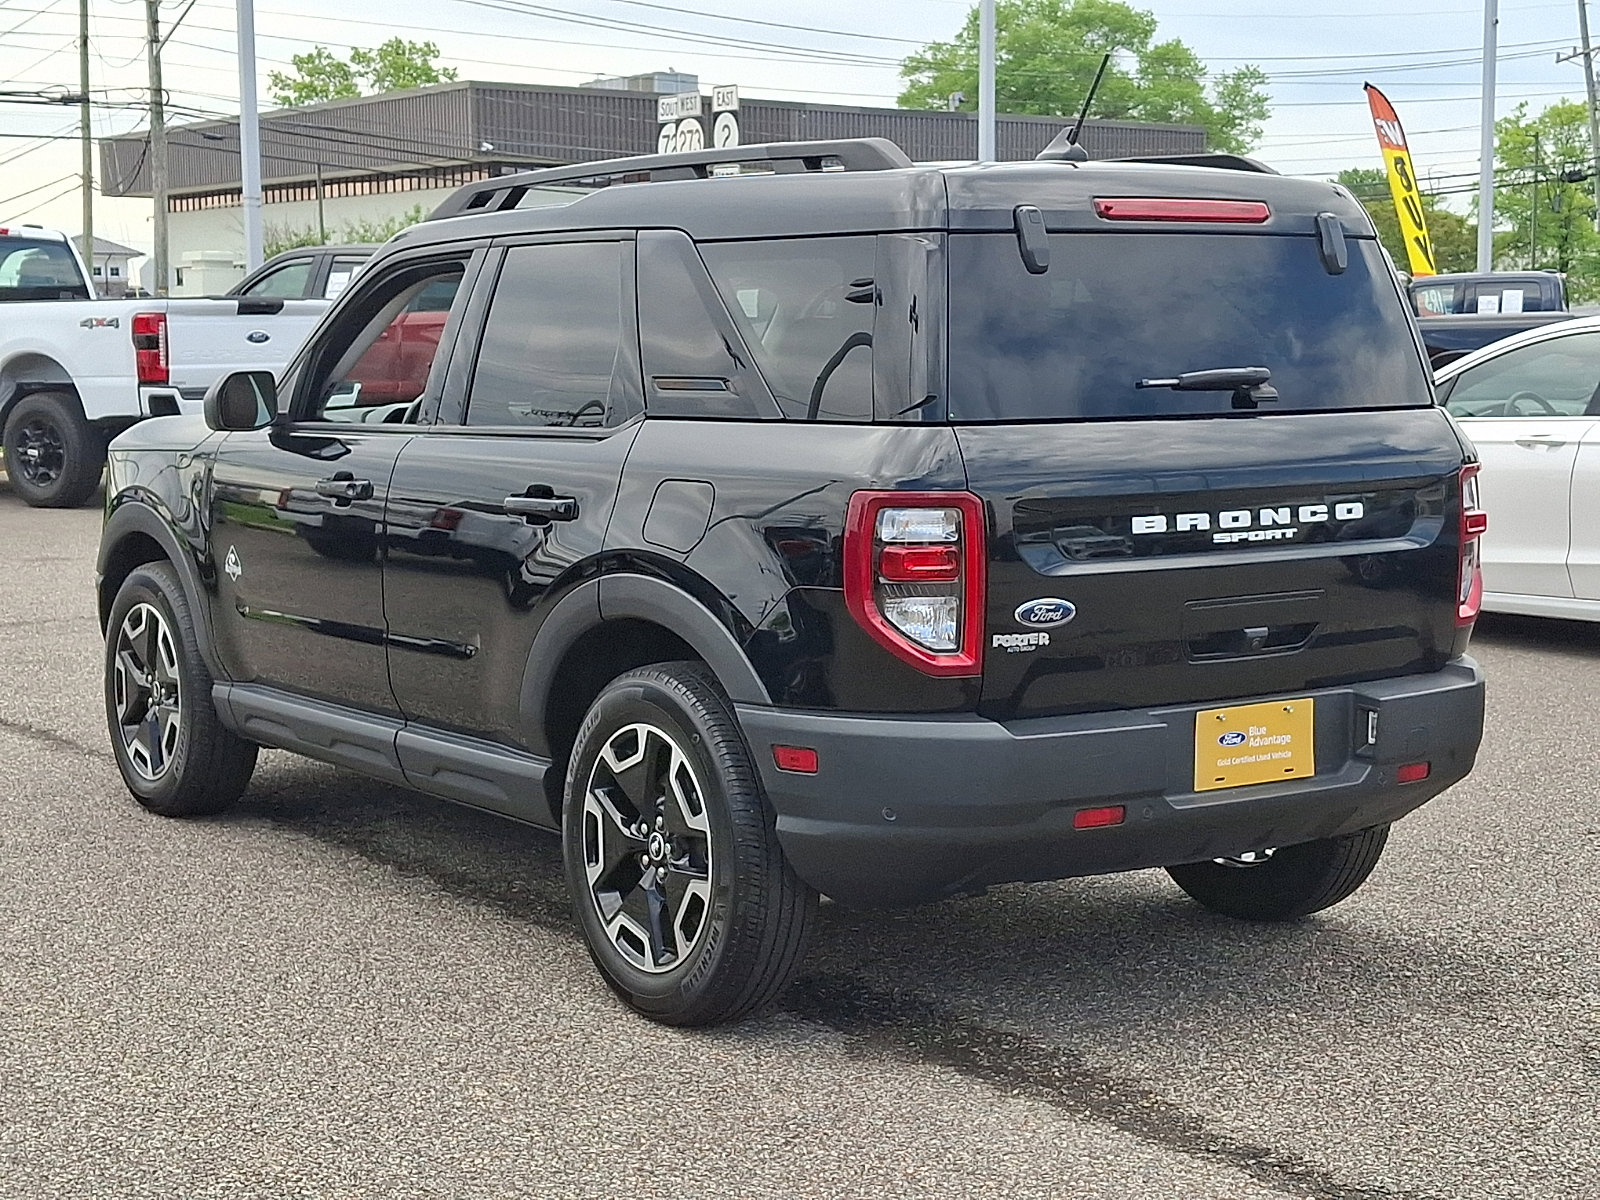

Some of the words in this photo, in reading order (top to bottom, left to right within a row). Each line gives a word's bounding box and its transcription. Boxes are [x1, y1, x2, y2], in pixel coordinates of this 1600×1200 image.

[716, 91, 734, 107] EAST
[660, 101, 678, 117] SOUT
[1131, 502, 1364, 534] BRONCO
[1212, 528, 1298, 544] SPORT
[1030, 605, 1064, 622] Ford
[992, 632, 1050, 648] PORTER
[1248, 726, 1267, 737] Blue
[1248, 734, 1292, 748] Advantage
[1217, 757, 1231, 767] Gold
[1231, 755, 1256, 766] Certified
[1256, 753, 1271, 763] Used
[1271, 750, 1292, 761] Vehicle
